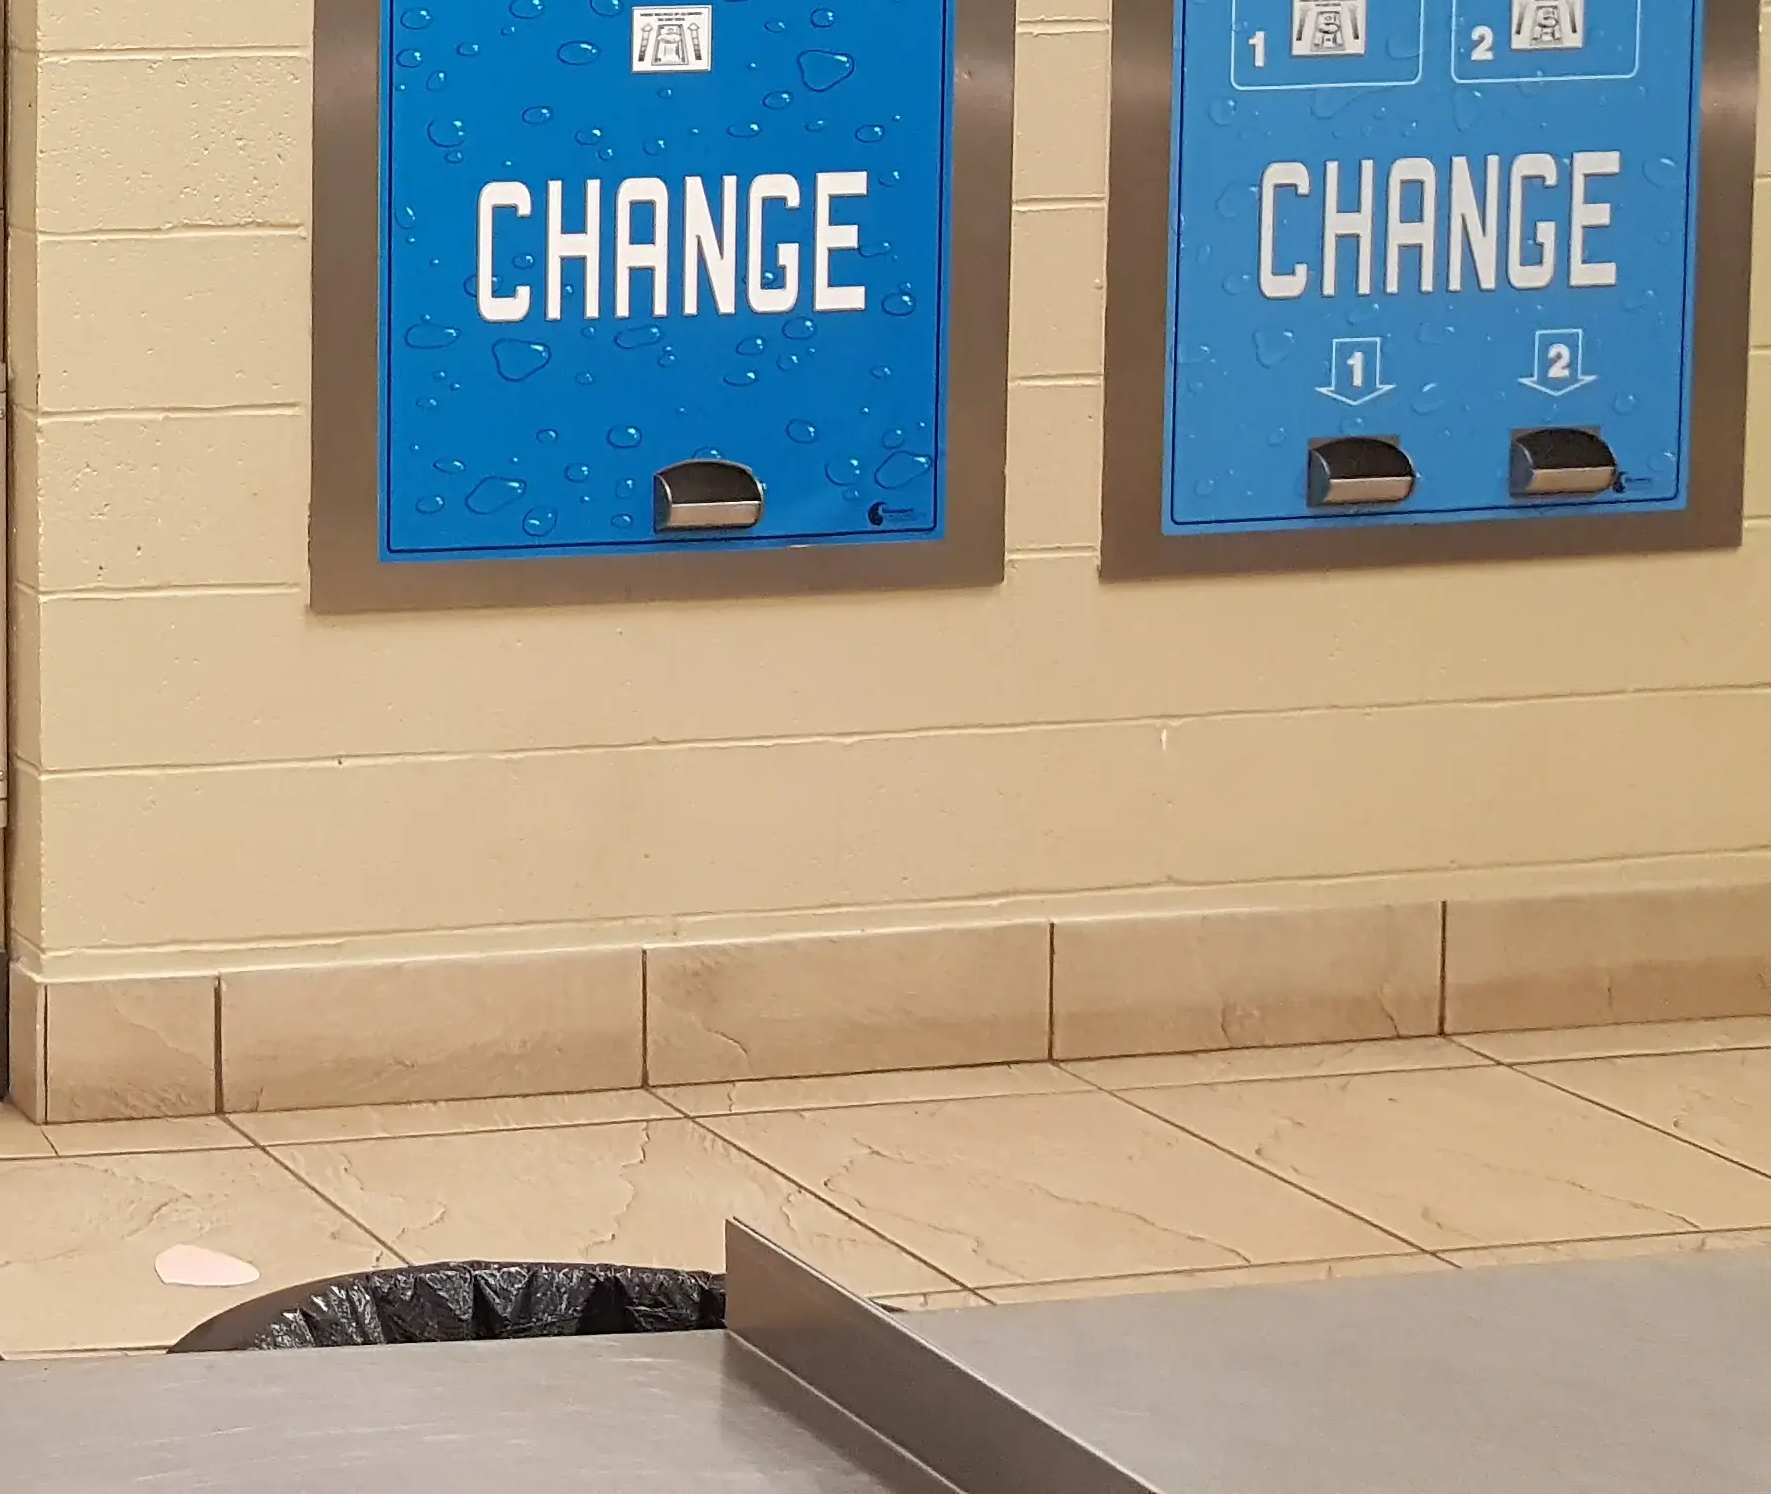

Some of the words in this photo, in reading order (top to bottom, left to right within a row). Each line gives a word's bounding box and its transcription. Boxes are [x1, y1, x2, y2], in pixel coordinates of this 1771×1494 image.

[1249, 31, 1265, 67] 1
[1471, 26, 1493, 60] 2
[1260, 151, 1620, 298] CHANGE
[478, 171, 867, 325] CHANGE
[1347, 352, 1363, 386] 1
[1548, 344, 1570, 378] 2
